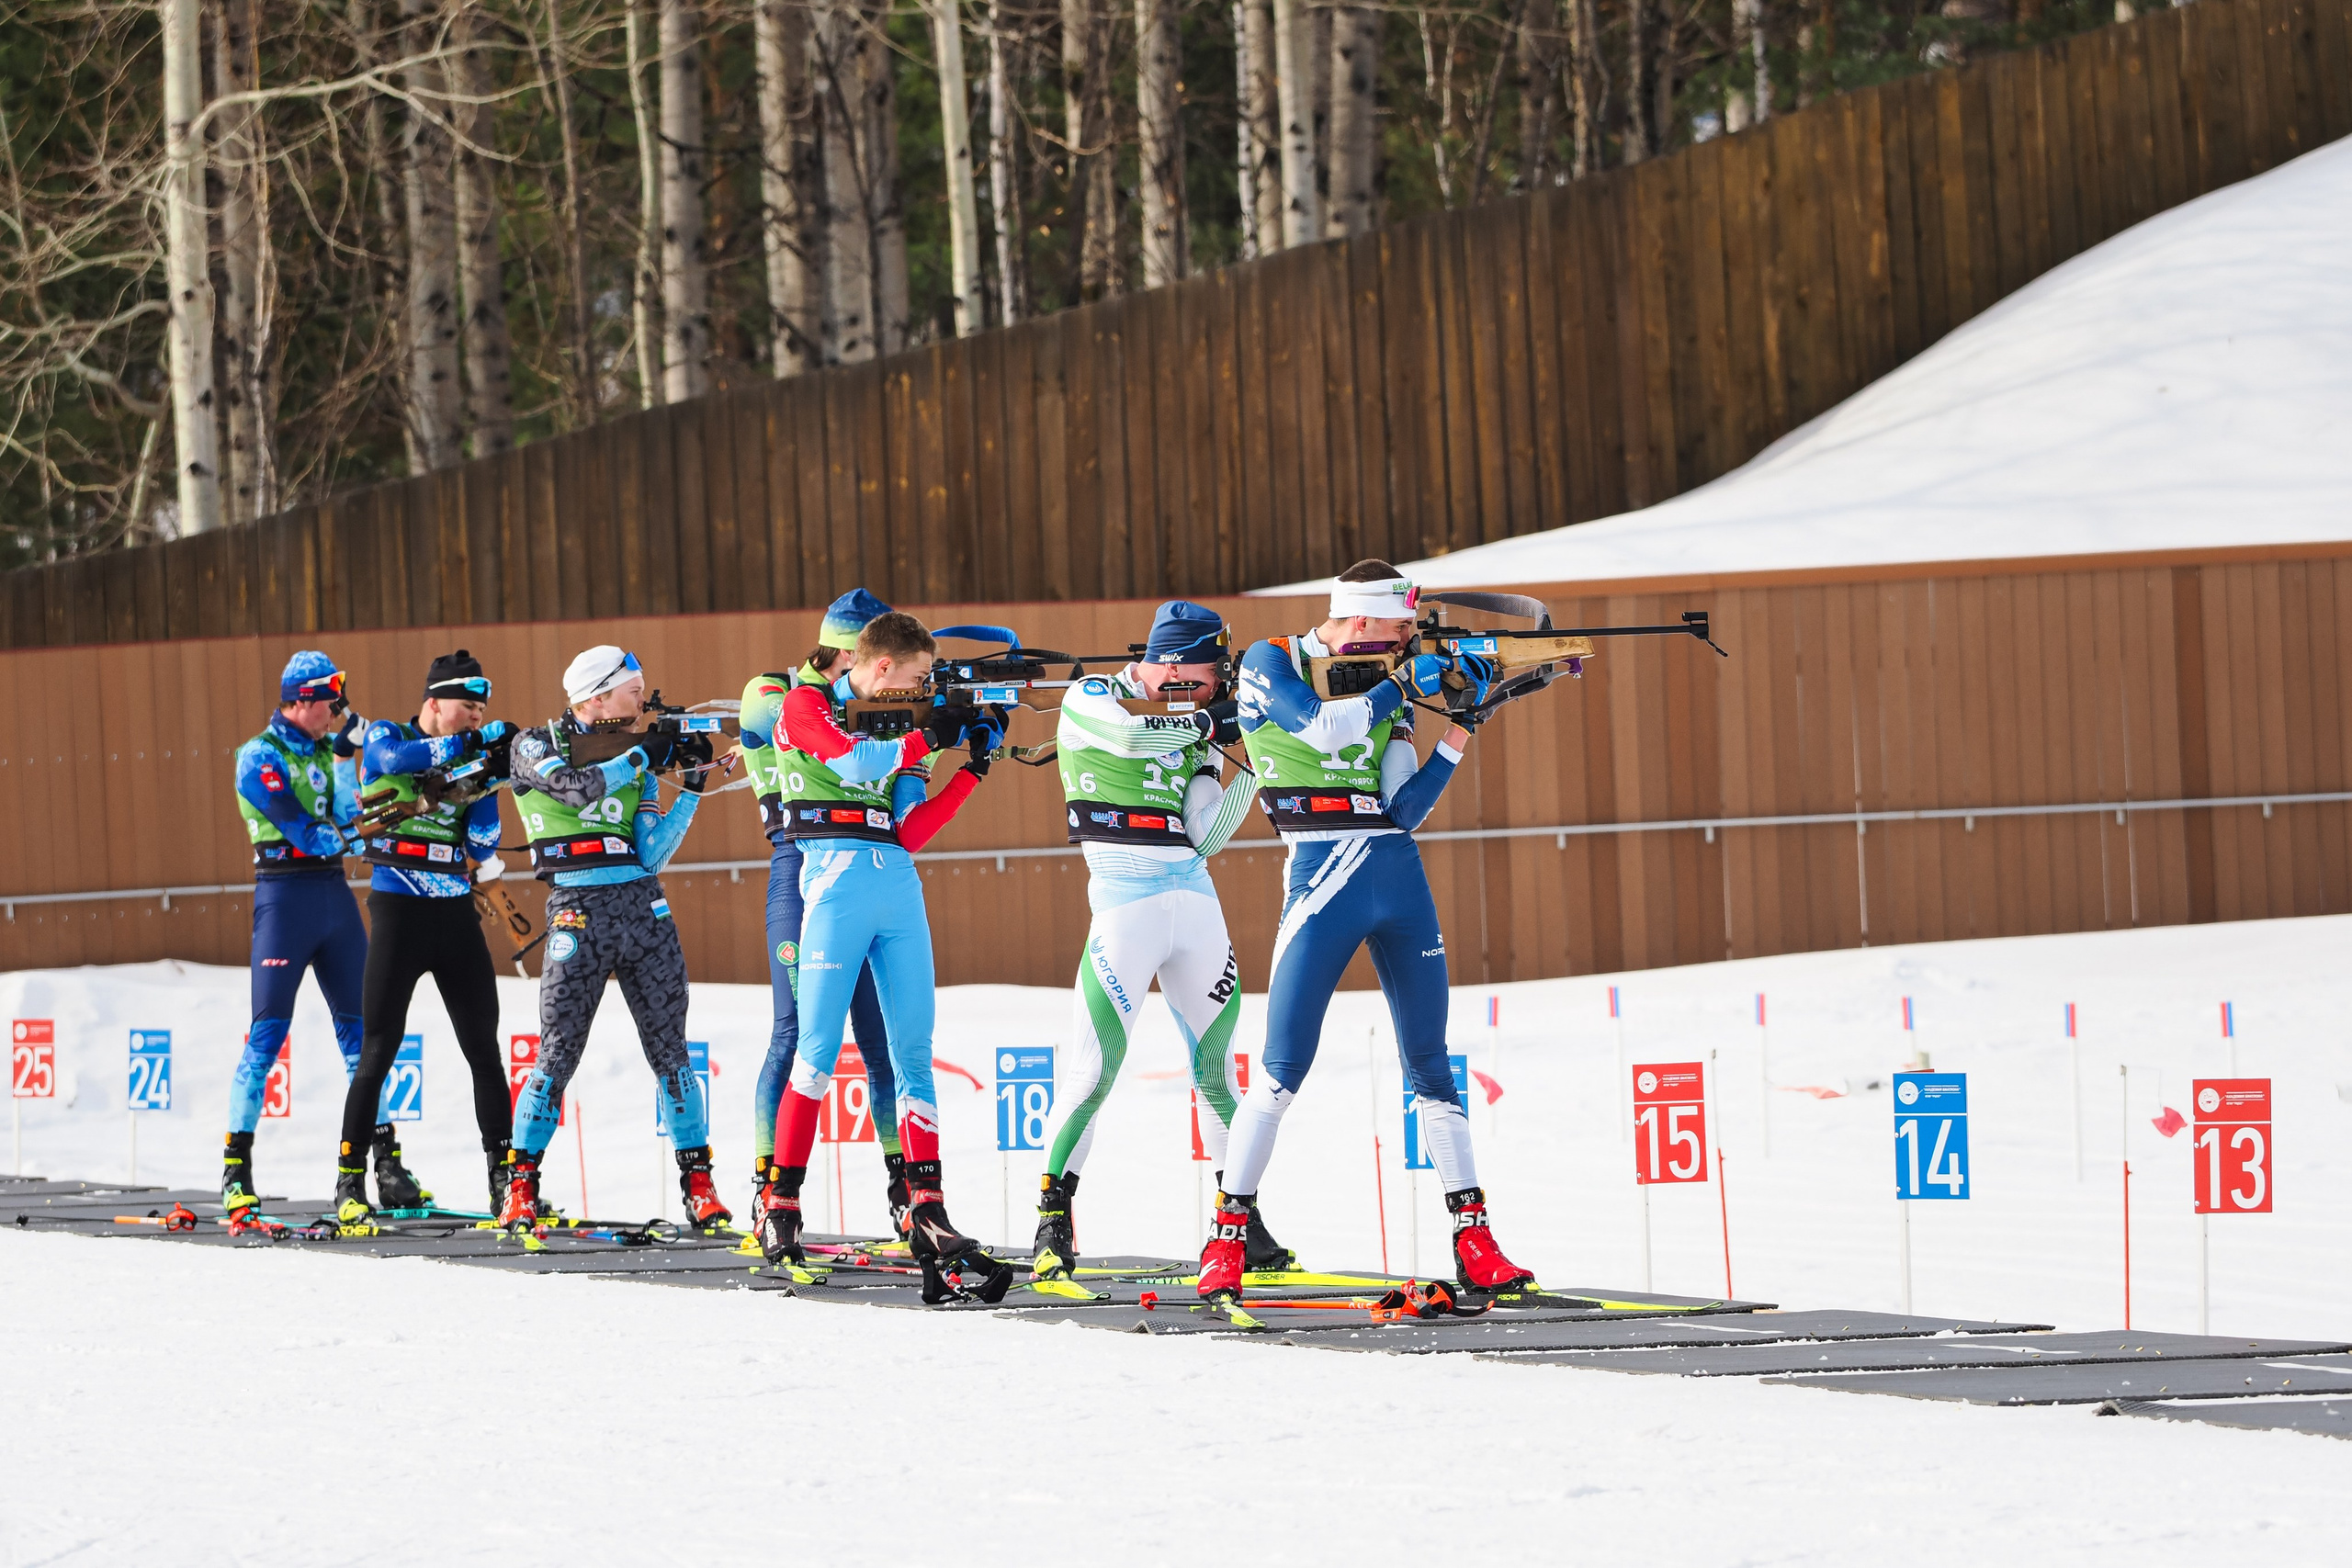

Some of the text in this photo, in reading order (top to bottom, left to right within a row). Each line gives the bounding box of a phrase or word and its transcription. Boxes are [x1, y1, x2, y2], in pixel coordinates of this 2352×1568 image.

[750, 766, 778, 791] 17
[778, 772, 805, 795] 20
[1062, 770, 1097, 794] 16
[1097, 956, 1132, 1013] ЮГОРИЯ
[14, 1046, 53, 1097] 25
[129, 1056, 170, 1110] 24
[261, 1063, 288, 1117] 3
[825, 1078, 870, 1141] 19
[1001, 1084, 1048, 1147] 18
[685, 1151, 699, 1159] 179
[1641, 1105, 1701, 1180] 15
[1899, 1119, 1964, 1196] 14
[2200, 1126, 2266, 1210] 13
[919, 1165, 934, 1174] 170
[1459, 1192, 1476, 1202] 162
[1498, 1293, 1521, 1302] FISCHER
